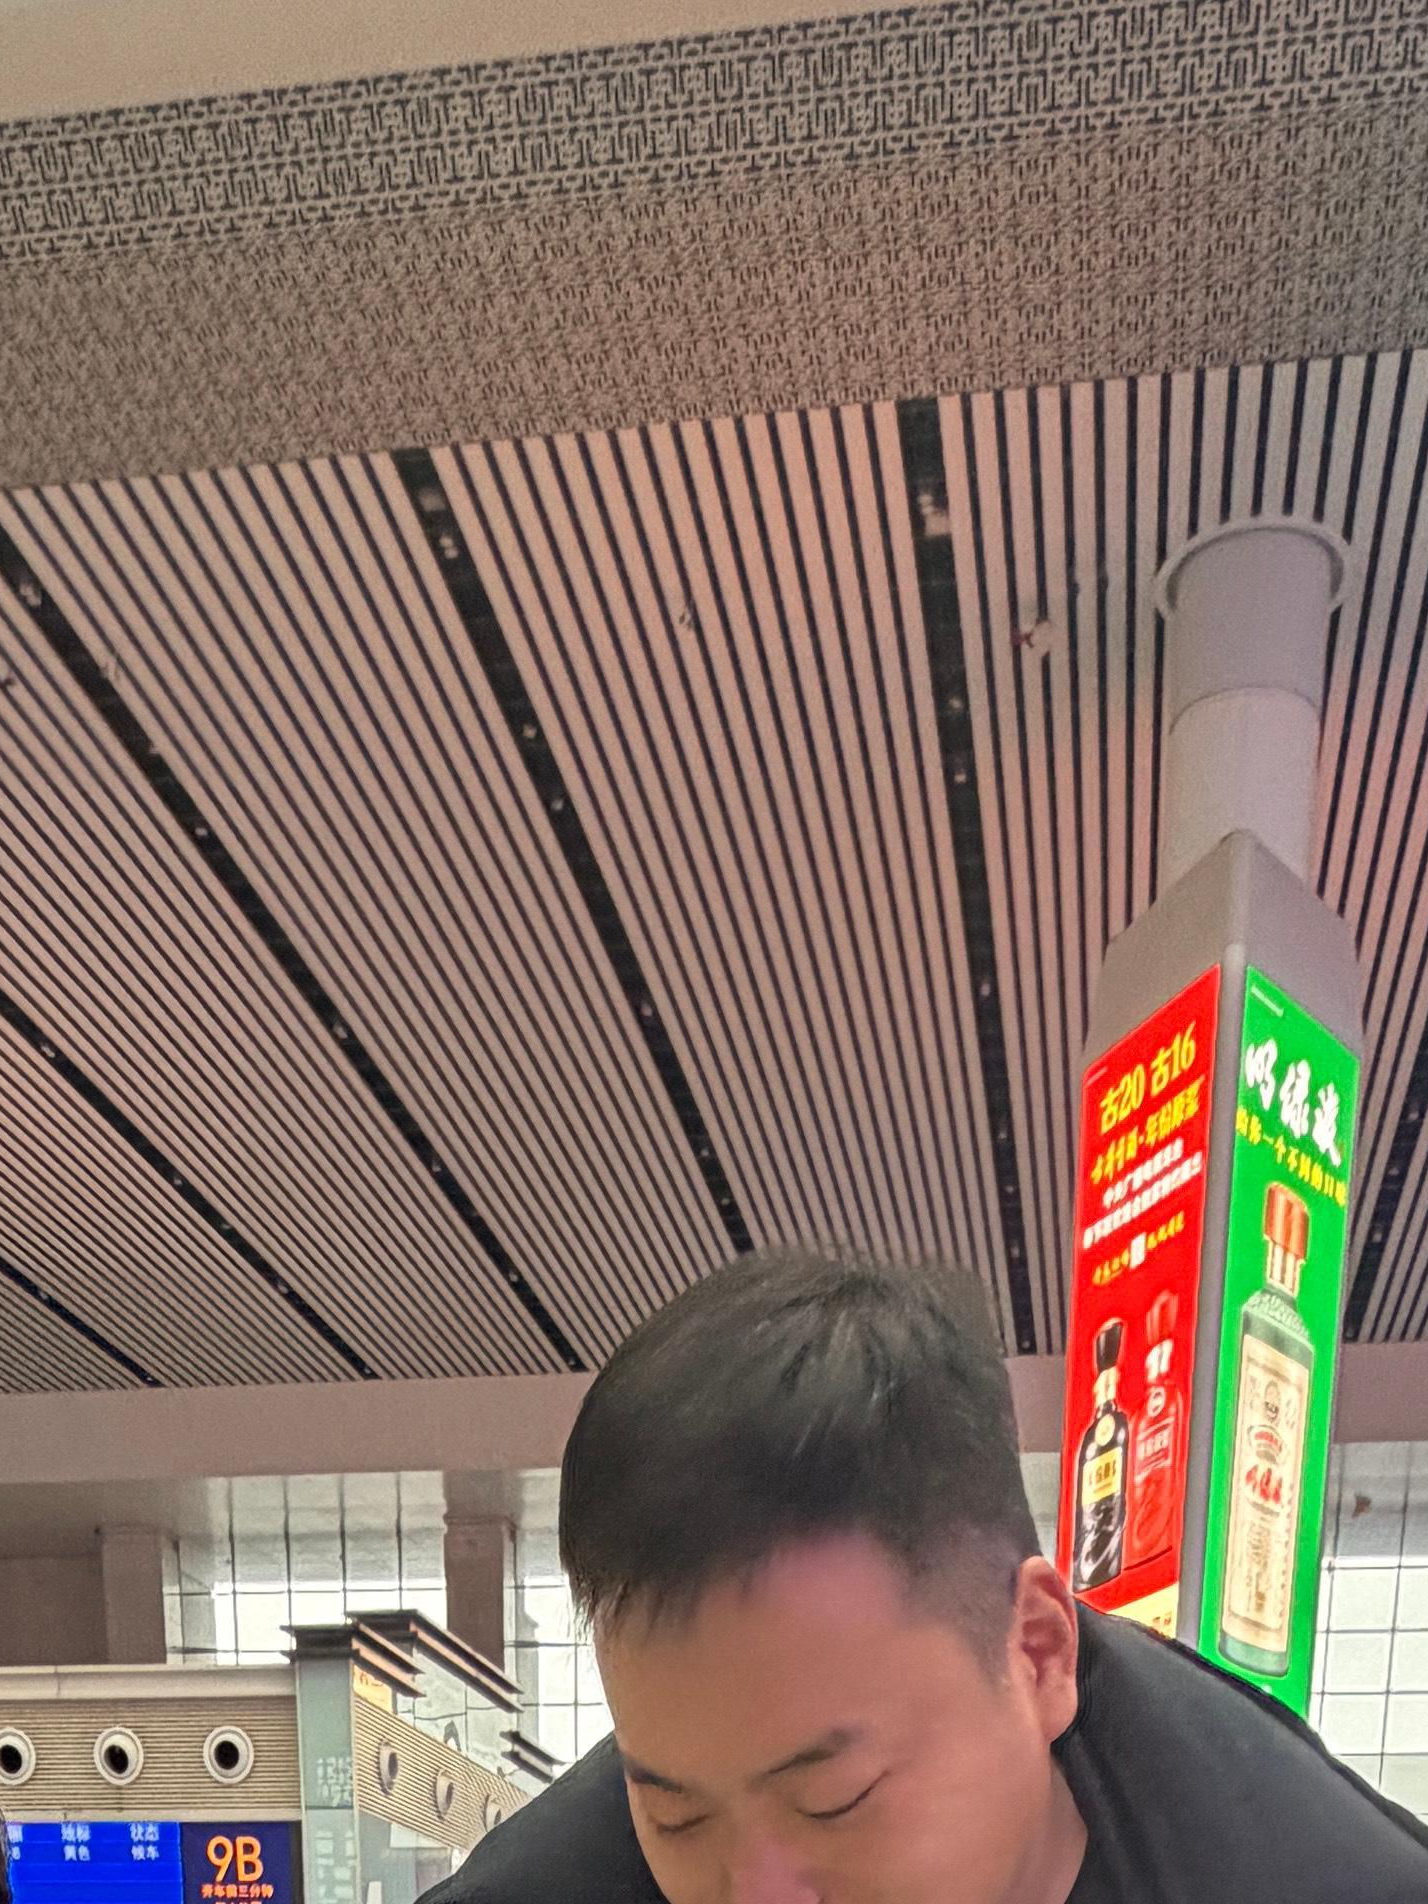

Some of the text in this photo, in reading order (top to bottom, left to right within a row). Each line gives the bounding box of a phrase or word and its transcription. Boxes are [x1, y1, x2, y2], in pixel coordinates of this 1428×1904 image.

[1100, 1020, 1196, 1136] 古20 古16
[130, 1823, 159, 1842] 状态
[64, 1844, 89, 1861] 黄色
[206, 1835, 264, 1882] 9B
[201, 1883, 274, 1899] 开车前三分钟
